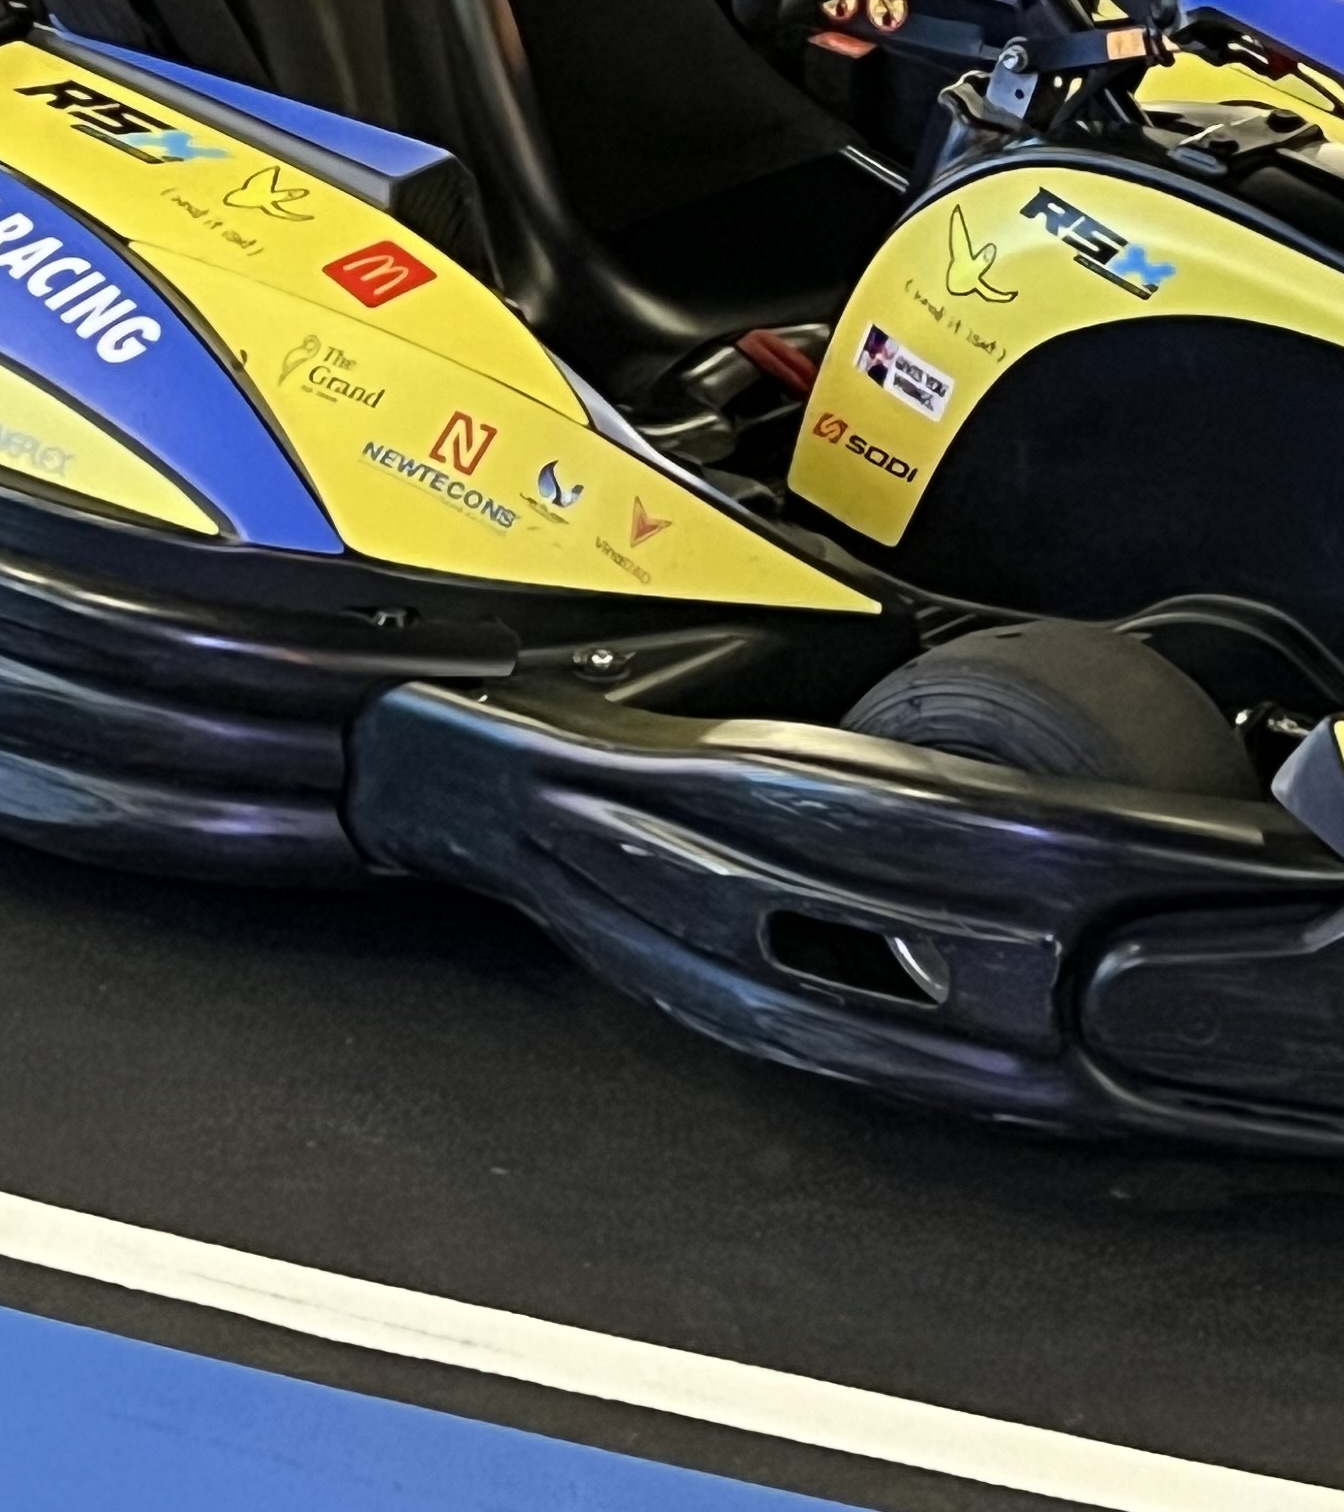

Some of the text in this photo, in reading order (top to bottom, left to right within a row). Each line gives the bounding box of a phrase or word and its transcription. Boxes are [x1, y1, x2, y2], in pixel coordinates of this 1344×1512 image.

[323, 345, 358, 370] The
[308, 364, 386, 409] Grand
[845, 434, 919, 483] SODI
[361, 441, 518, 529] NEWTECONS
